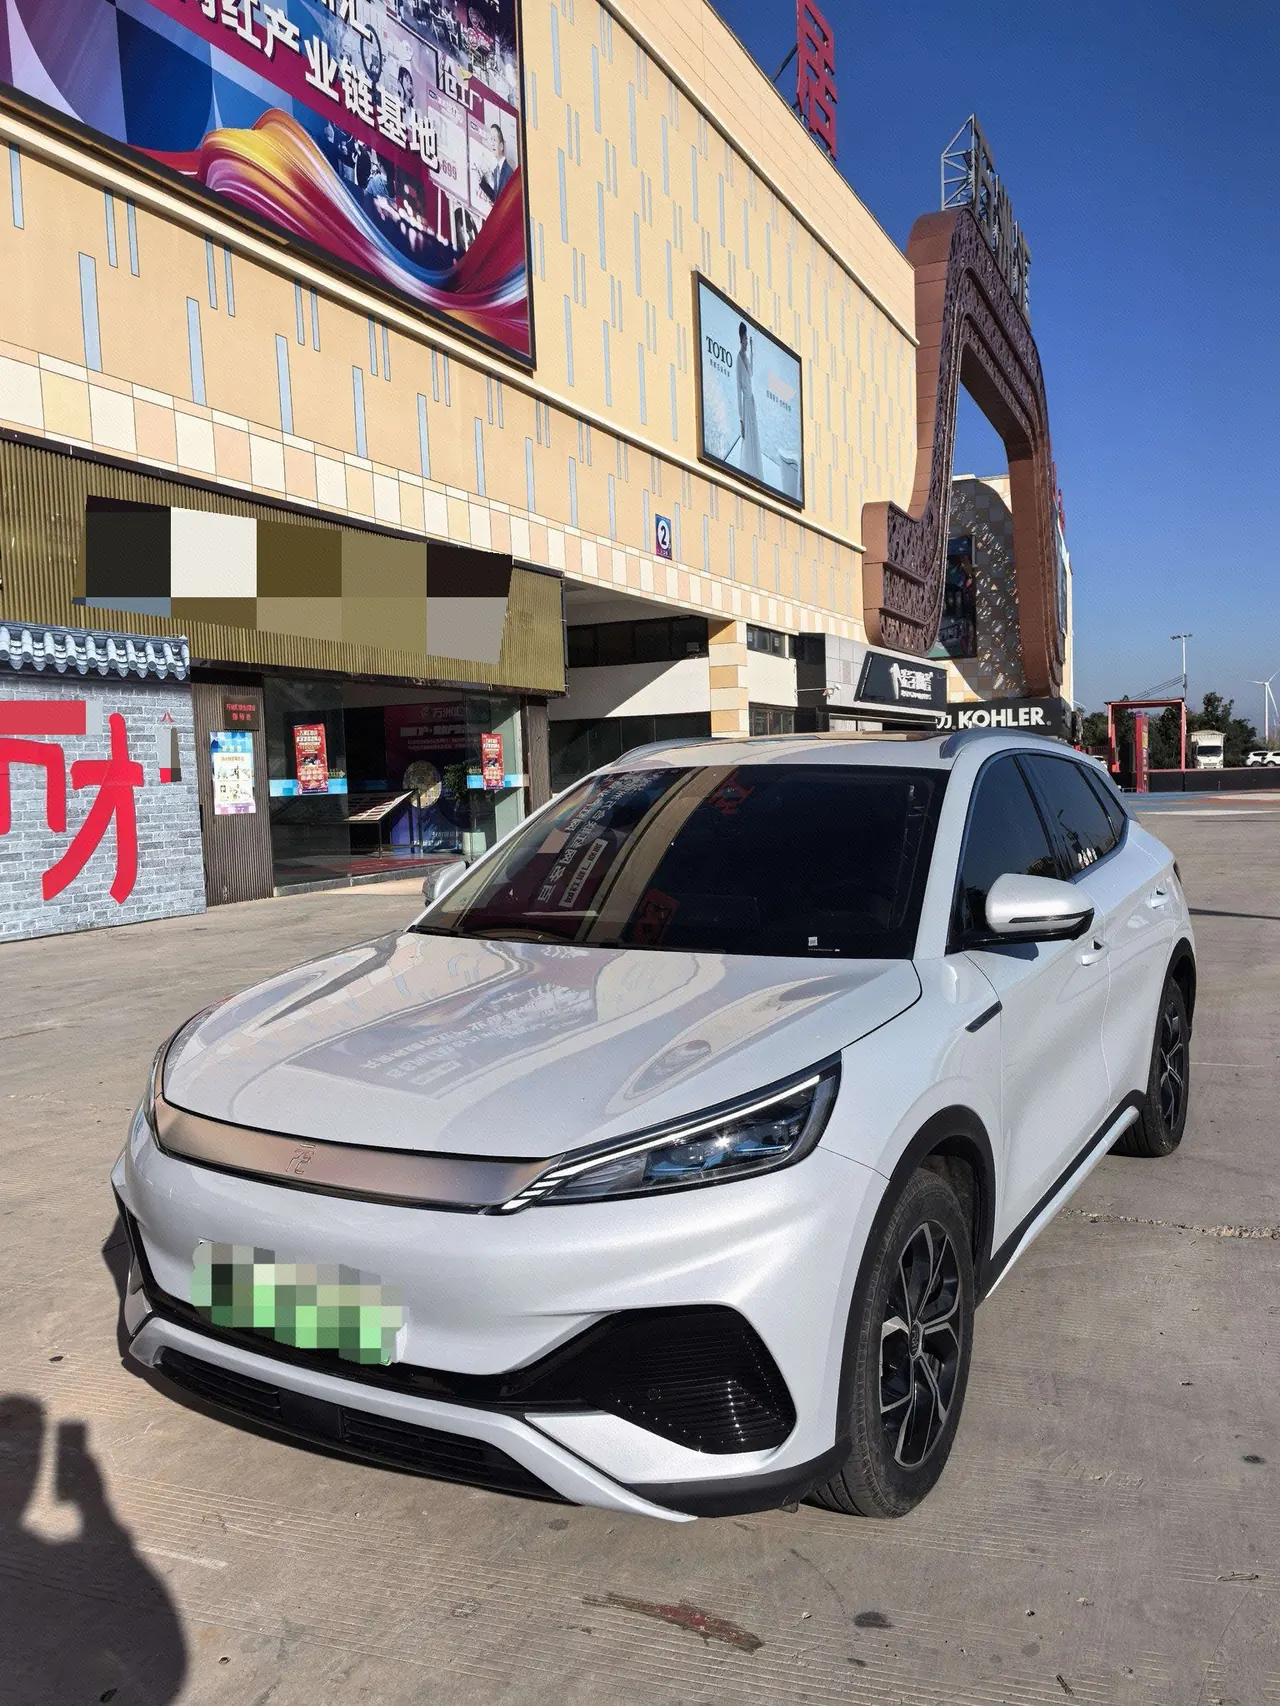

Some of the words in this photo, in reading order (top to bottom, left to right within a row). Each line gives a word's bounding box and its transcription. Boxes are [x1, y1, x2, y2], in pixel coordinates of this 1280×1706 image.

[200, 0, 439, 169] 红产业链基地
[705, 336, 733, 368] TOTO
[660, 525, 667, 546] 2
[958, 707, 1045, 728] KOHLER
